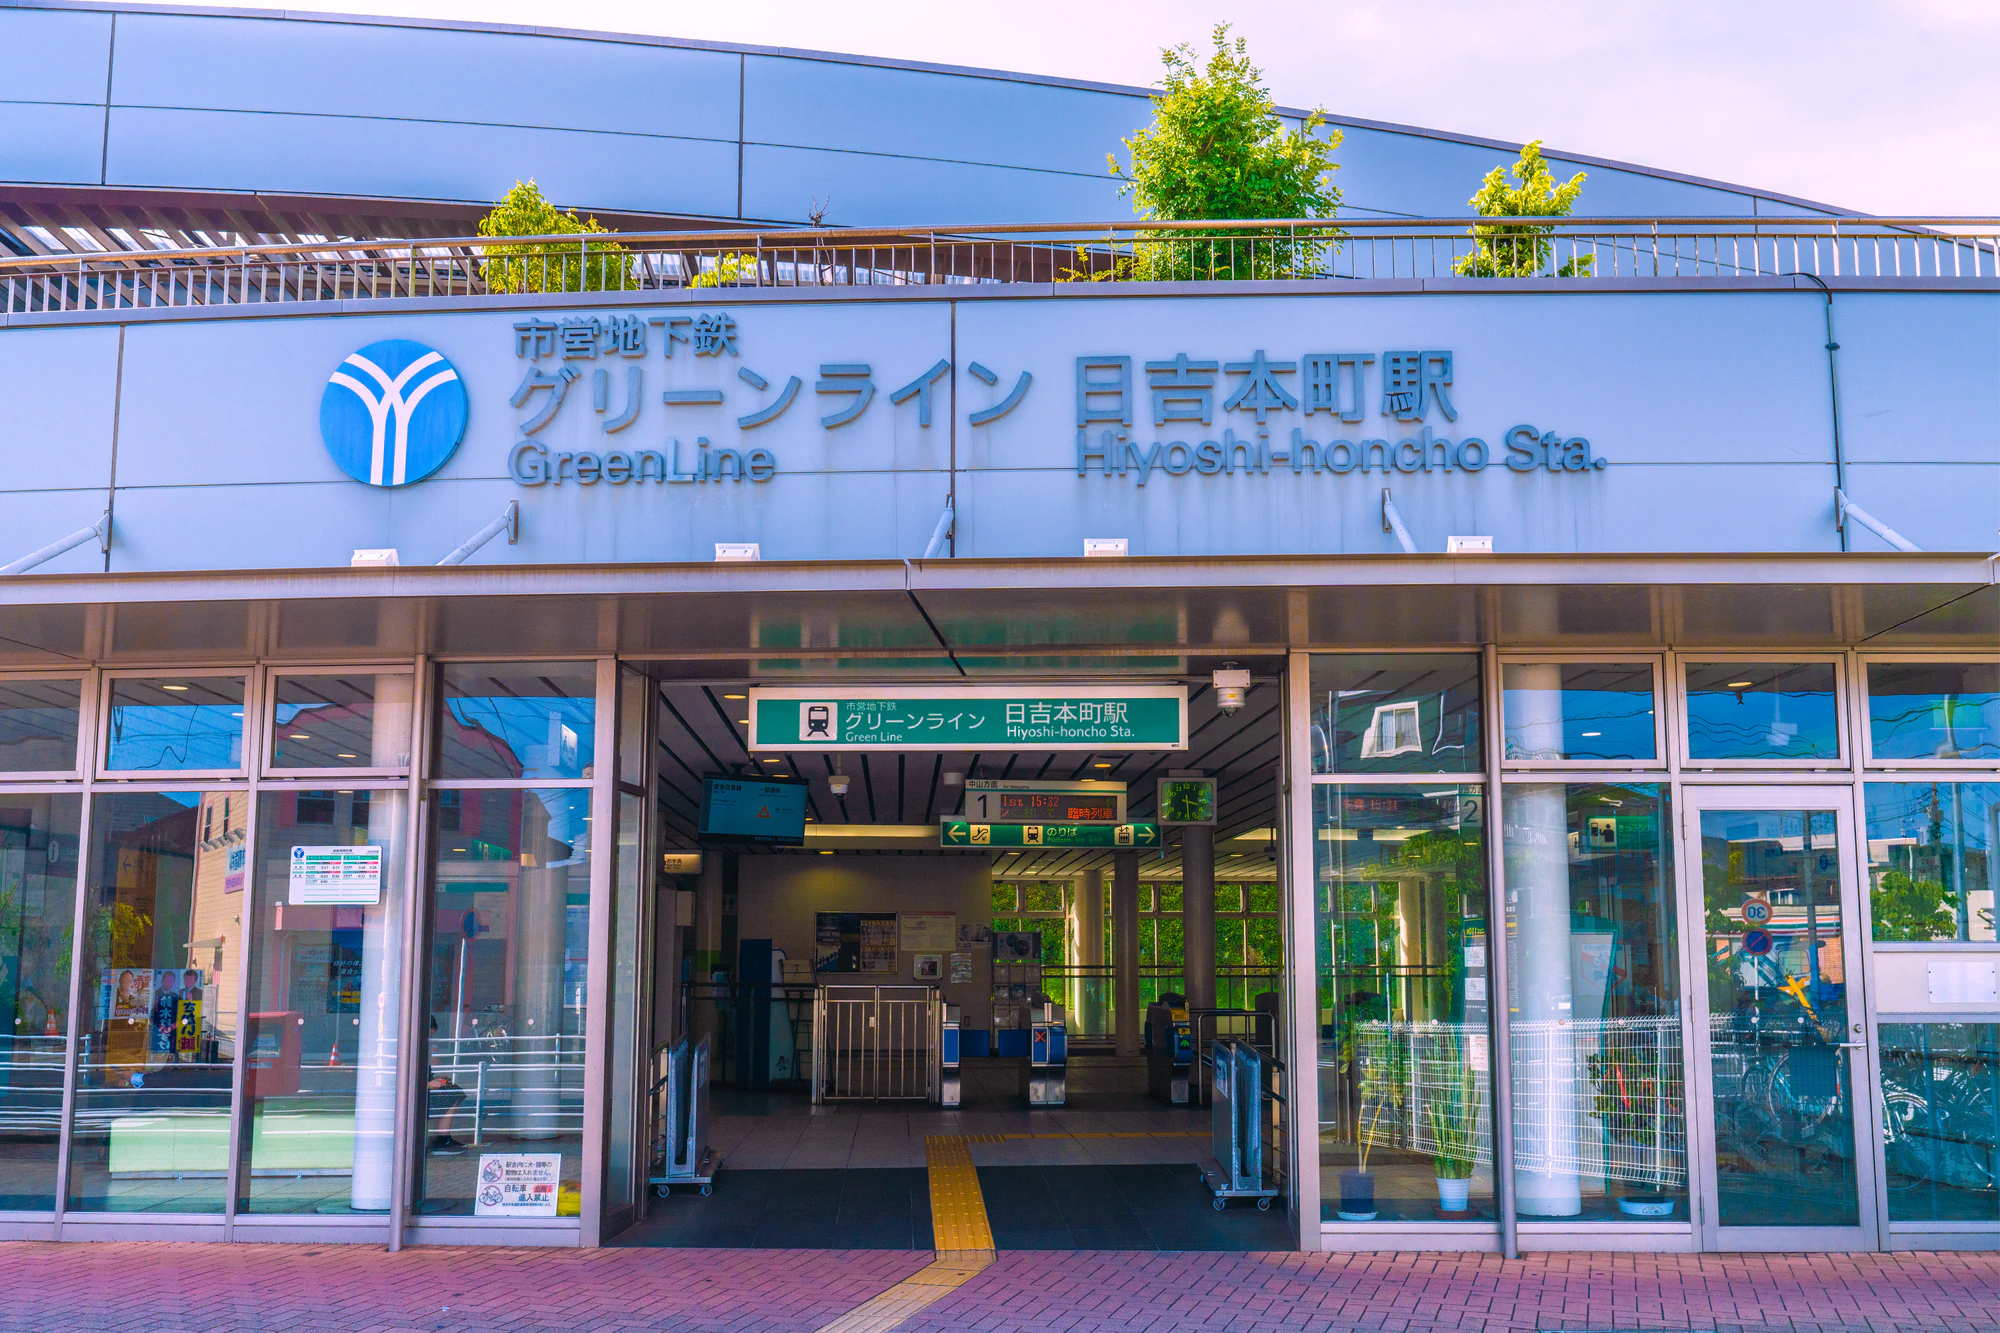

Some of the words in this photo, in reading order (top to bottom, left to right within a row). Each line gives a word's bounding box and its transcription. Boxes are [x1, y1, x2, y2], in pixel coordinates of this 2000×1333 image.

[513, 311, 739, 362] 市営地下鉄
[1076, 349, 1458, 427] 日吉本町駅
[509, 358, 1033, 436] グリーンライン
[1076, 427, 1489, 487] Hiyoshi-honcho
[1506, 424, 1608, 472] Sta.
[846, 701, 897, 712] 市営地下鉄
[1004, 702, 1128, 725] 日吉本町駅
[845, 713, 986, 730] グリーンライン
[846, 732, 878, 742] Green
[880, 732, 903, 742] Line
[1006, 726, 1108, 738] Hiyoshi-honcho
[1110, 726, 1135, 738] Sta.
[968, 780, 998, 788] 中山方面
[977, 794, 987, 818] 1
[1002, 796, 1024, 807] 1st
[1031, 796, 1059, 807] 15:32
[1464, 800, 1478, 823] 2
[1046, 827, 1078, 836] のりば
[504, 1184, 527, 1193] 自転車
